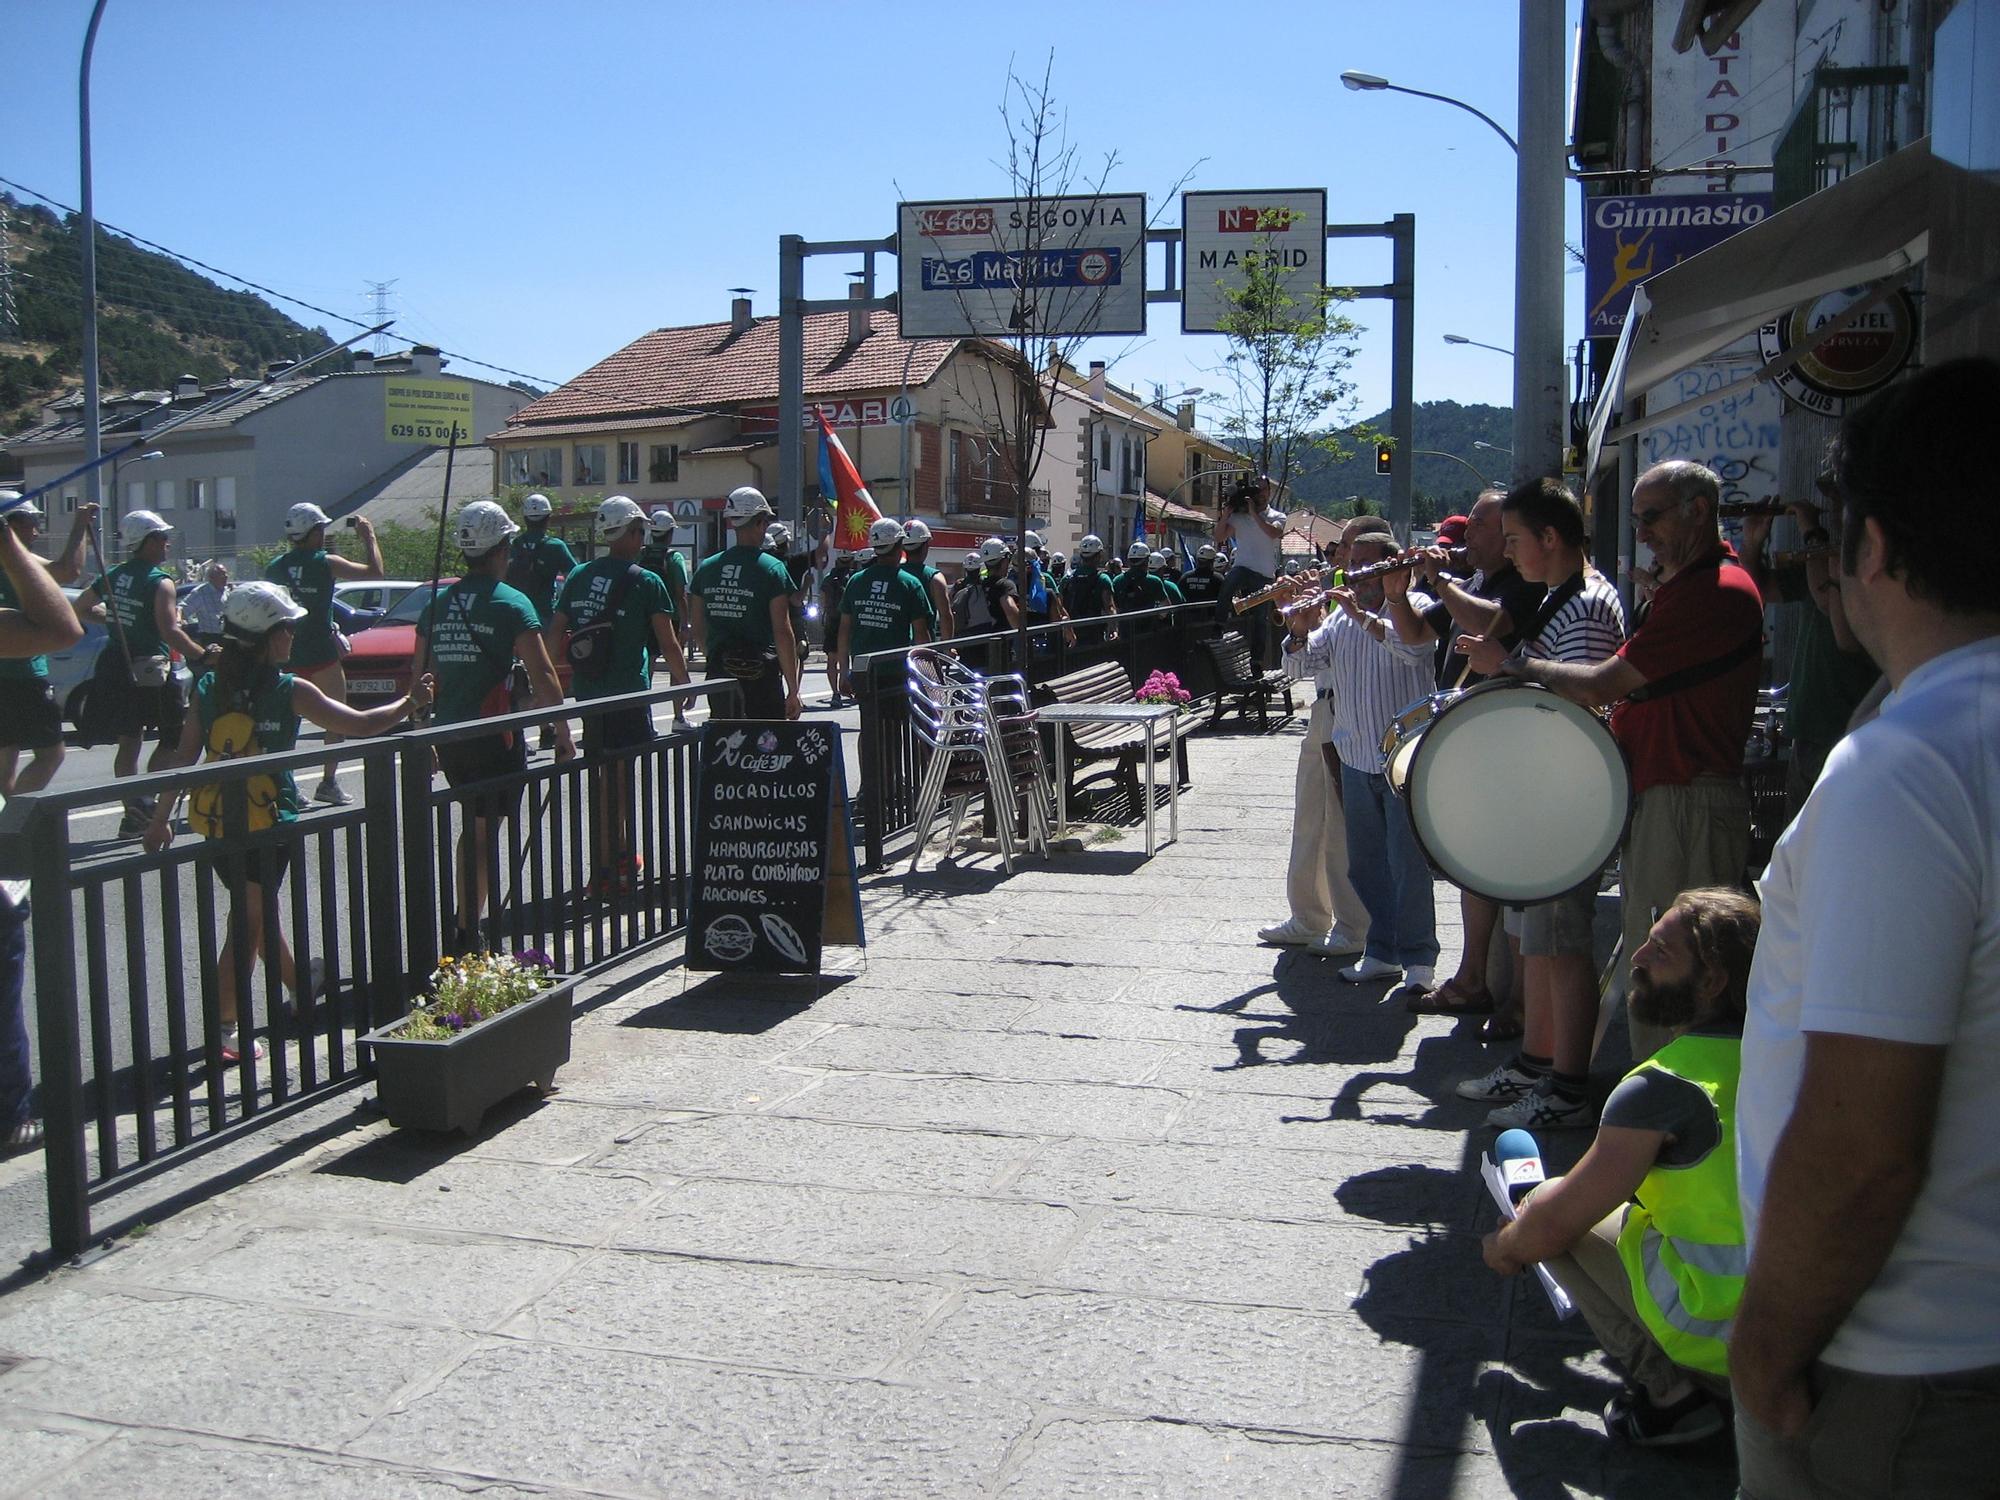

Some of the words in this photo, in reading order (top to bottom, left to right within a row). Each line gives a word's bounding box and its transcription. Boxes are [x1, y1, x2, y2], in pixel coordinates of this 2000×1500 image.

[920, 211, 990, 232] N-603
[1009, 207, 1127, 229] SEGOVIA
[1595, 197, 1765, 229] Gimnasio
[932, 262, 971, 282] A-6
[1798, 388, 1834, 411] LUIS
[391, 424, 414, 437] 629
[417, 425, 432, 438] 63
[435, 427, 450, 439] 00
[721, 564, 742, 580] SI
[590, 576, 612, 594] SI
[870, 580, 889, 594] SI
[874, 607, 887, 615] LAS
[454, 633, 472, 641] LAS
[806, 728, 829, 756] JOSE
[708, 841, 818, 859] HAMBURGUESAS
[703, 864, 745, 881] PLATO
